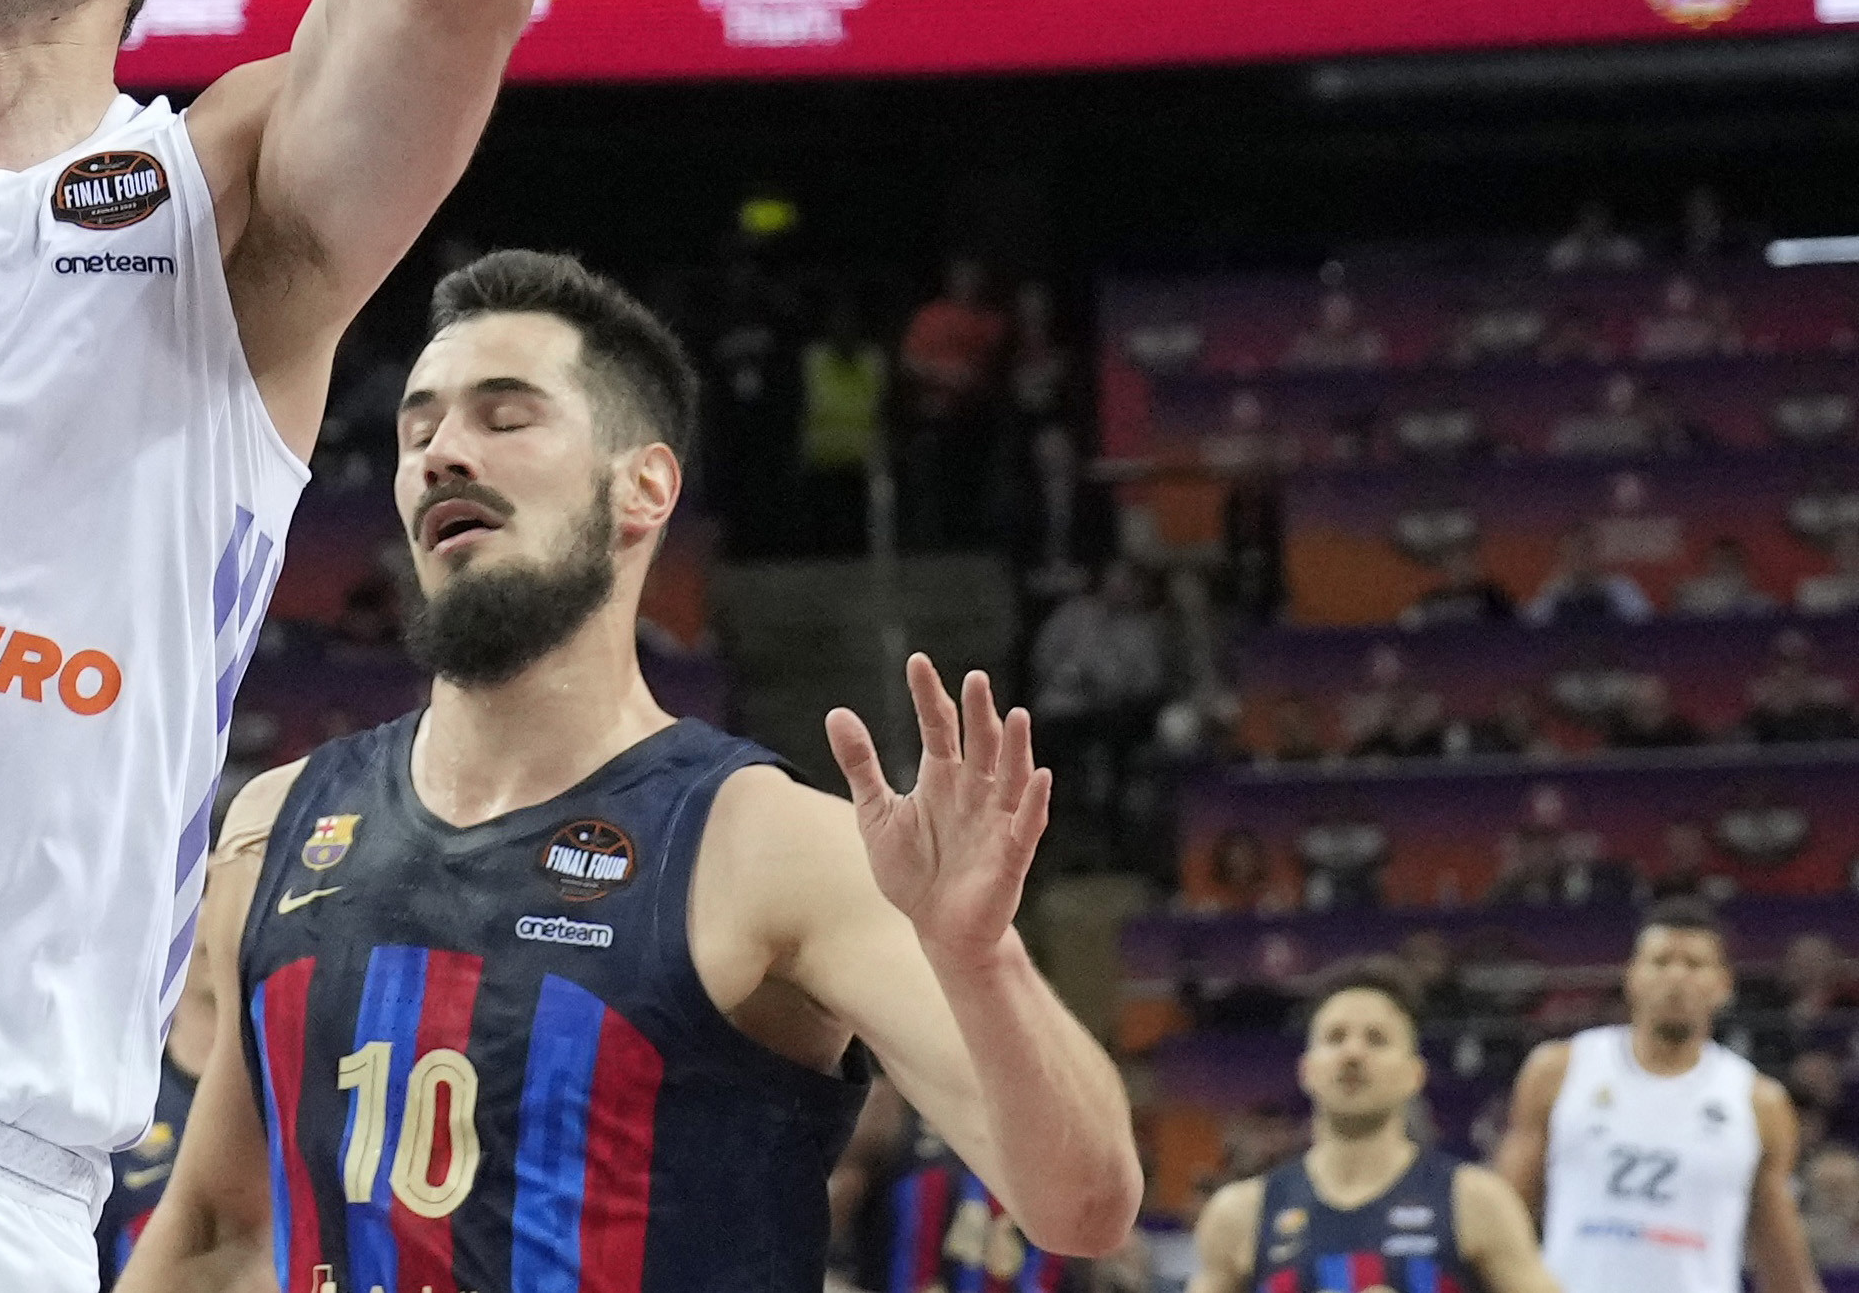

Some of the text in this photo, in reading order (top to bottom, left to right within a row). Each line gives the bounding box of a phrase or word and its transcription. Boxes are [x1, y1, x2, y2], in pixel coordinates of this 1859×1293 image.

[64, 168, 159, 209] FINAL FOUR
[55, 252, 175, 275] oneteam
[545, 844, 628, 880] FINAL FOUR
[519, 920, 609, 944] oneteam
[337, 1041, 481, 1218] 10
[1606, 1143, 1681, 1203] 22
